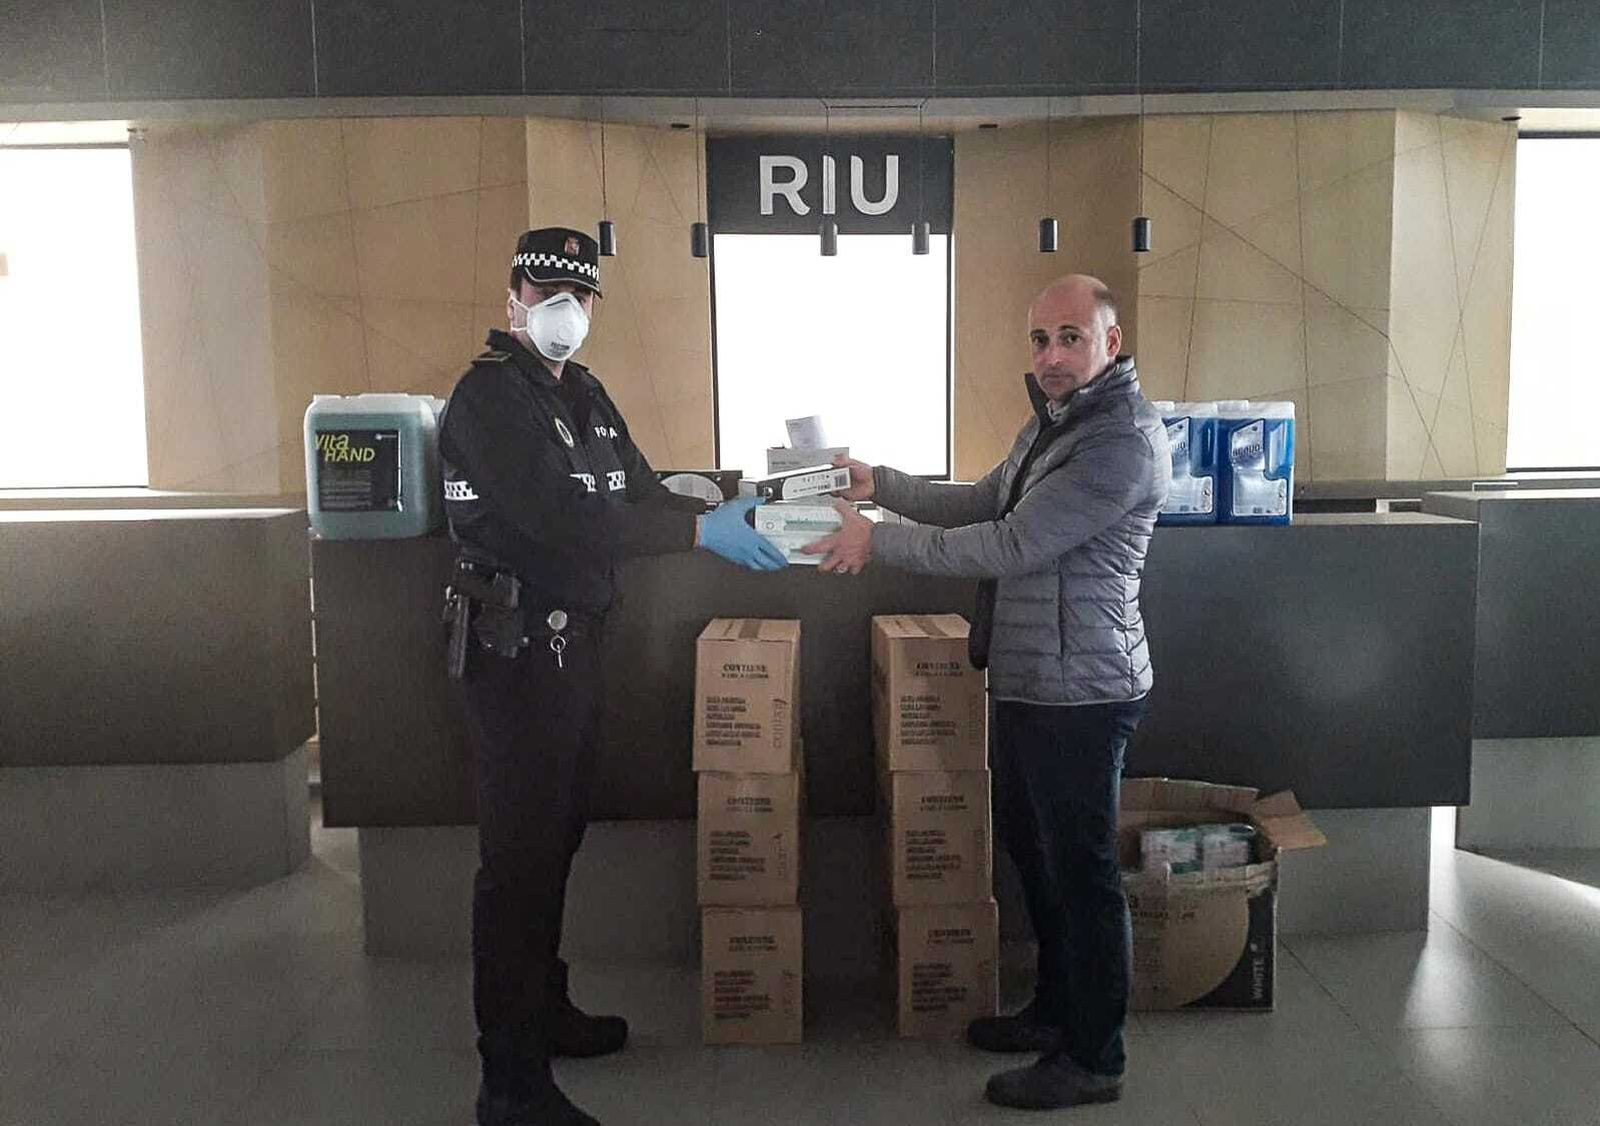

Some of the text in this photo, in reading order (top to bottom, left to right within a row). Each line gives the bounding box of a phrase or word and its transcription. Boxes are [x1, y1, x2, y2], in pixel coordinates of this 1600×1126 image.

[759, 154, 899, 216] RIU
[324, 447, 376, 462] HAND
[1250, 956, 1265, 1000] WHITE
